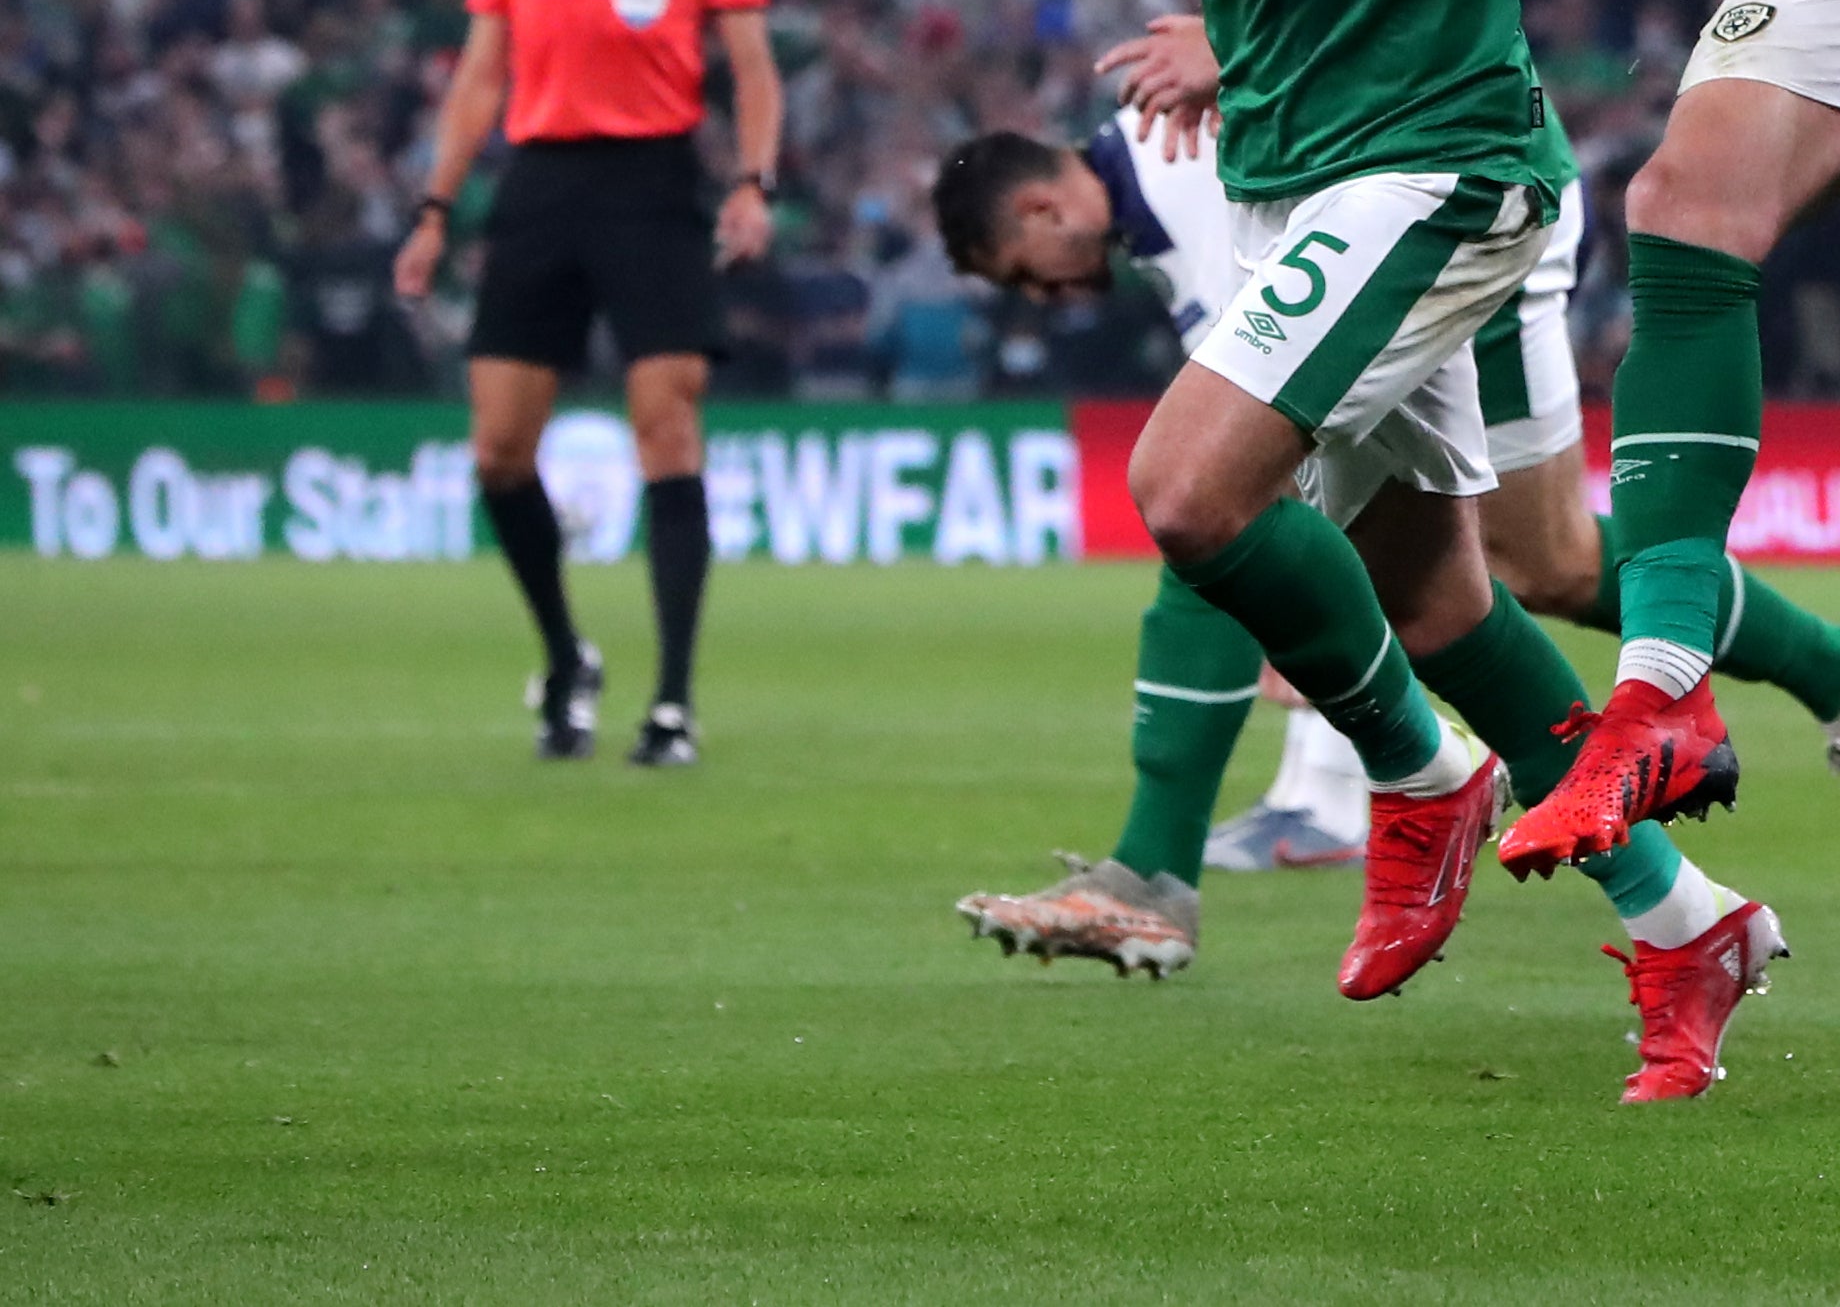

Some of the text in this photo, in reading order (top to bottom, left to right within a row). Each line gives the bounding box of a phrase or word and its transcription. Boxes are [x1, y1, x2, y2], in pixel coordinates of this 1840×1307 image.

[1260, 230, 1350, 317] 5
[1234, 327, 1272, 355] umbro
[14, 440, 476, 563] To Our Staff
